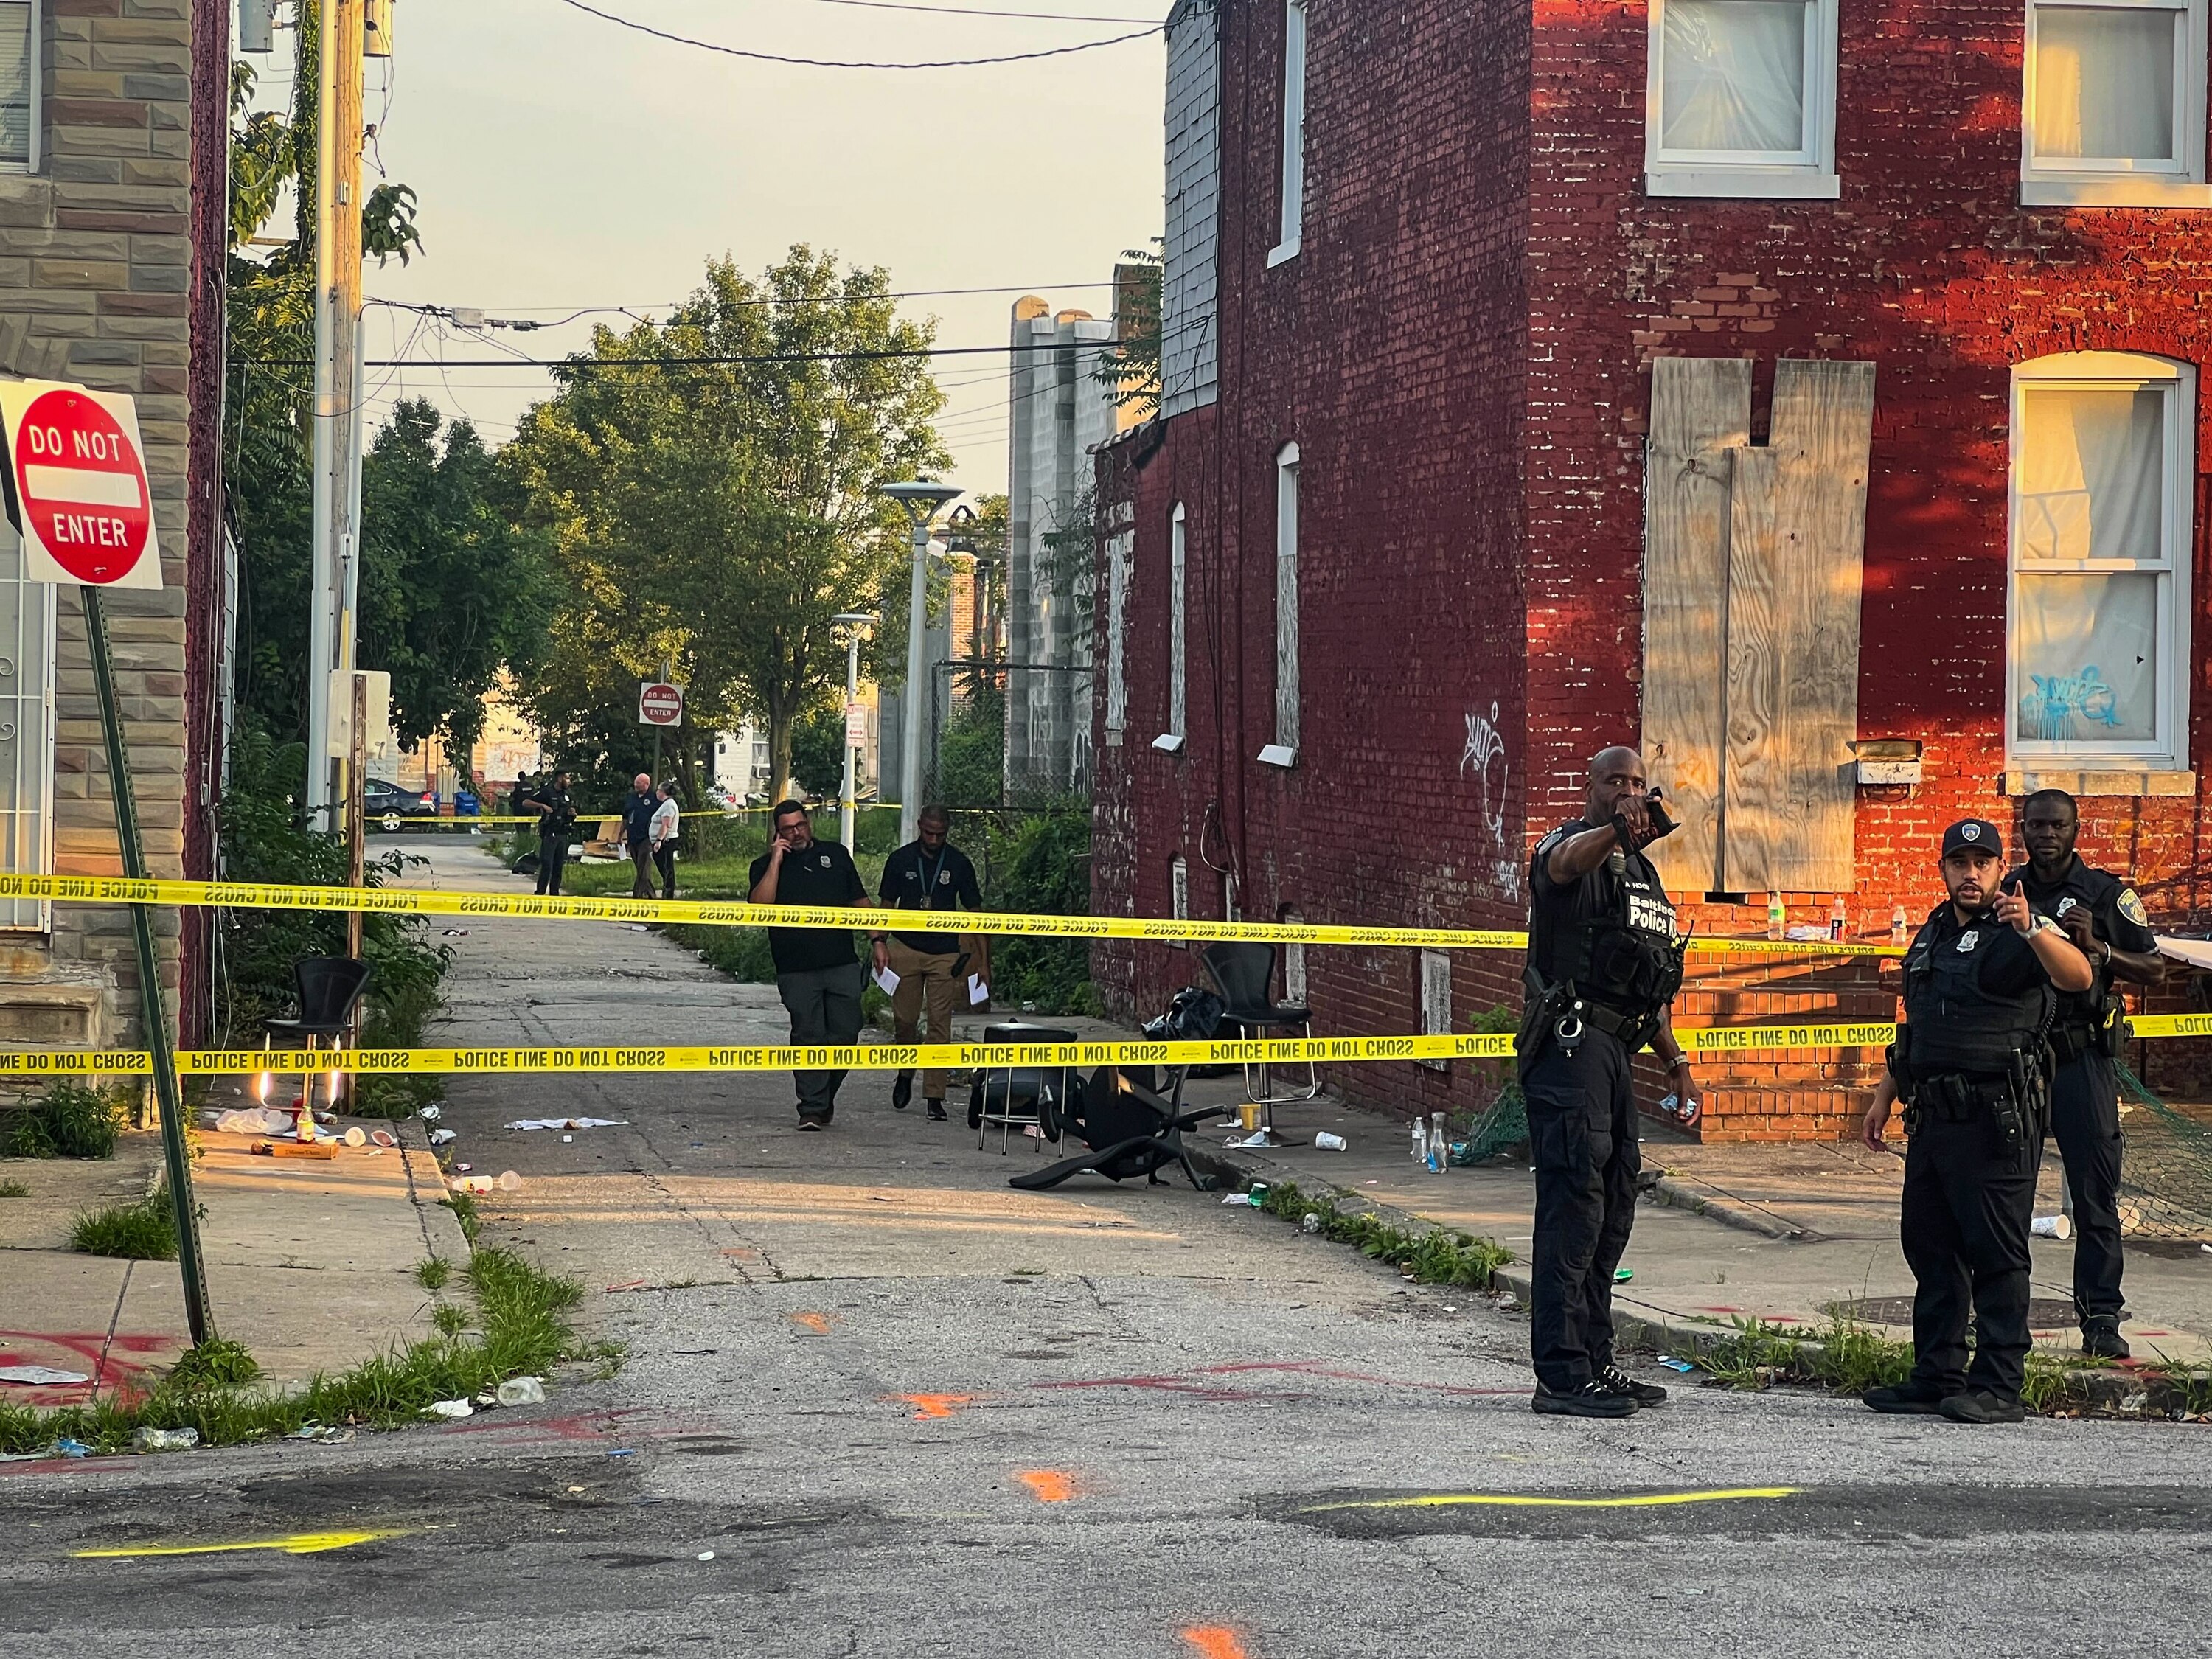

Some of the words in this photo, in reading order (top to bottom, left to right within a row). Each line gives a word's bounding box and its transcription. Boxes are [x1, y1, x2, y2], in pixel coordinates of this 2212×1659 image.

[29, 425, 63, 456] DO
[72, 431, 119, 462] NOT
[52, 513, 128, 547] ENTER
[1630, 905, 1667, 935] Police
